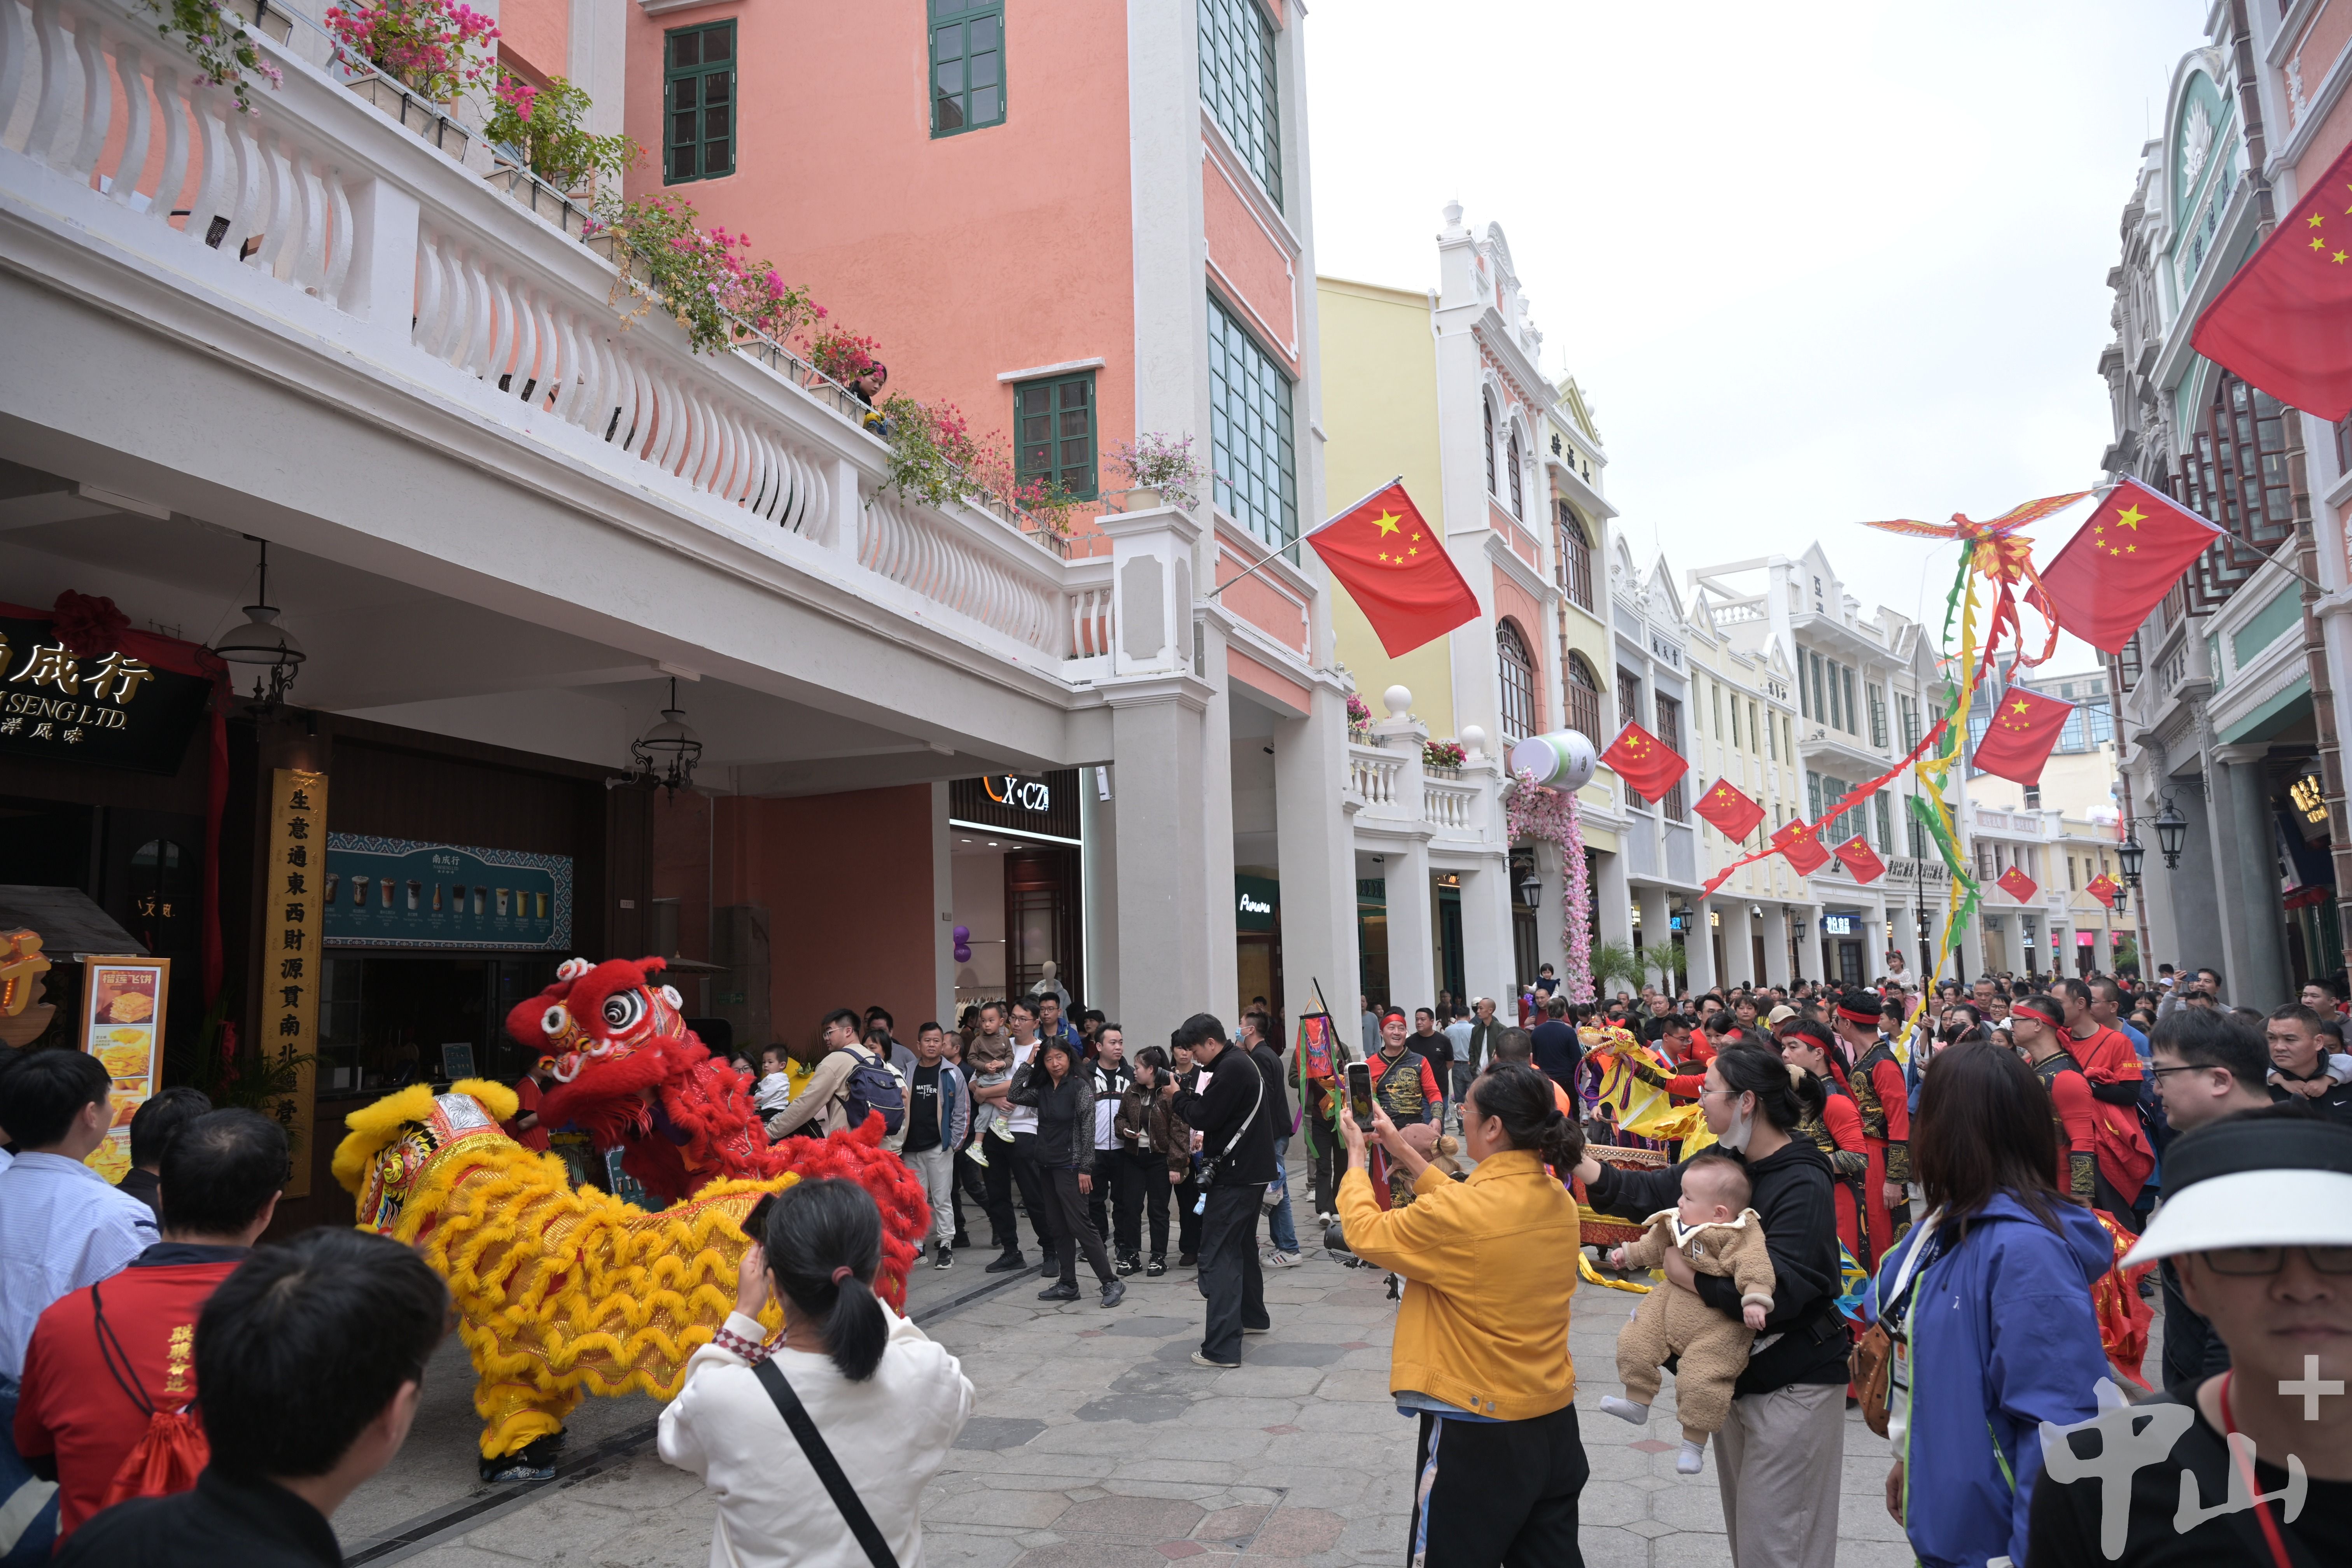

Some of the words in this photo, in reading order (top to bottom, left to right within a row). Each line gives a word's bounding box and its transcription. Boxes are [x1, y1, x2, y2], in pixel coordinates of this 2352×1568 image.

[6, 693, 77, 722] SENG
[0, 718, 84, 744] 洋风味
[432, 854, 460, 866] 南成行
[103, 974, 152, 984] 榴莲飞饼
